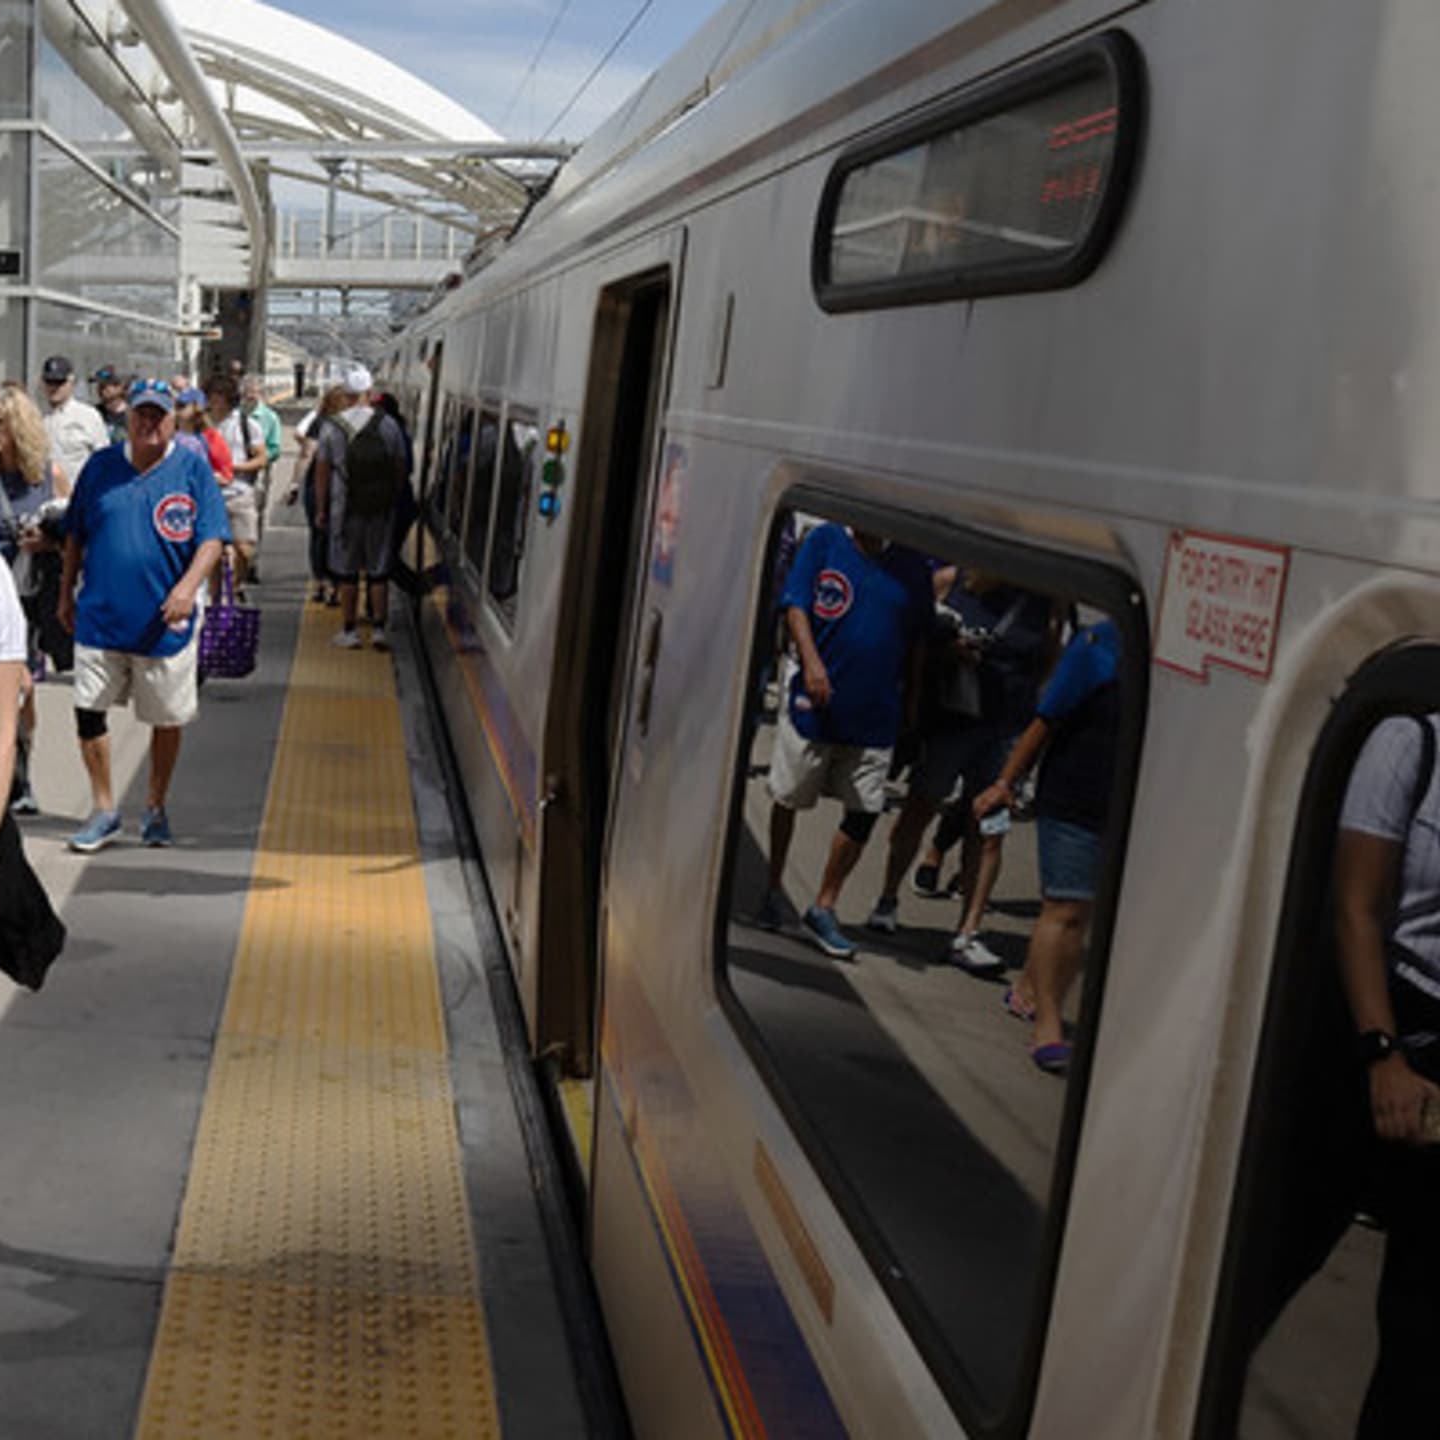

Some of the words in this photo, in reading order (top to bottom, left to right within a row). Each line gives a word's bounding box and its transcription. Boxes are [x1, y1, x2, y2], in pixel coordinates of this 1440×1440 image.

[1178, 548, 1206, 590] FOR
[1207, 554, 1250, 597] ENTRY
[1252, 566, 1277, 607] HIT
[1186, 599, 1229, 647] GLASS
[1230, 611, 1269, 661] HERE
